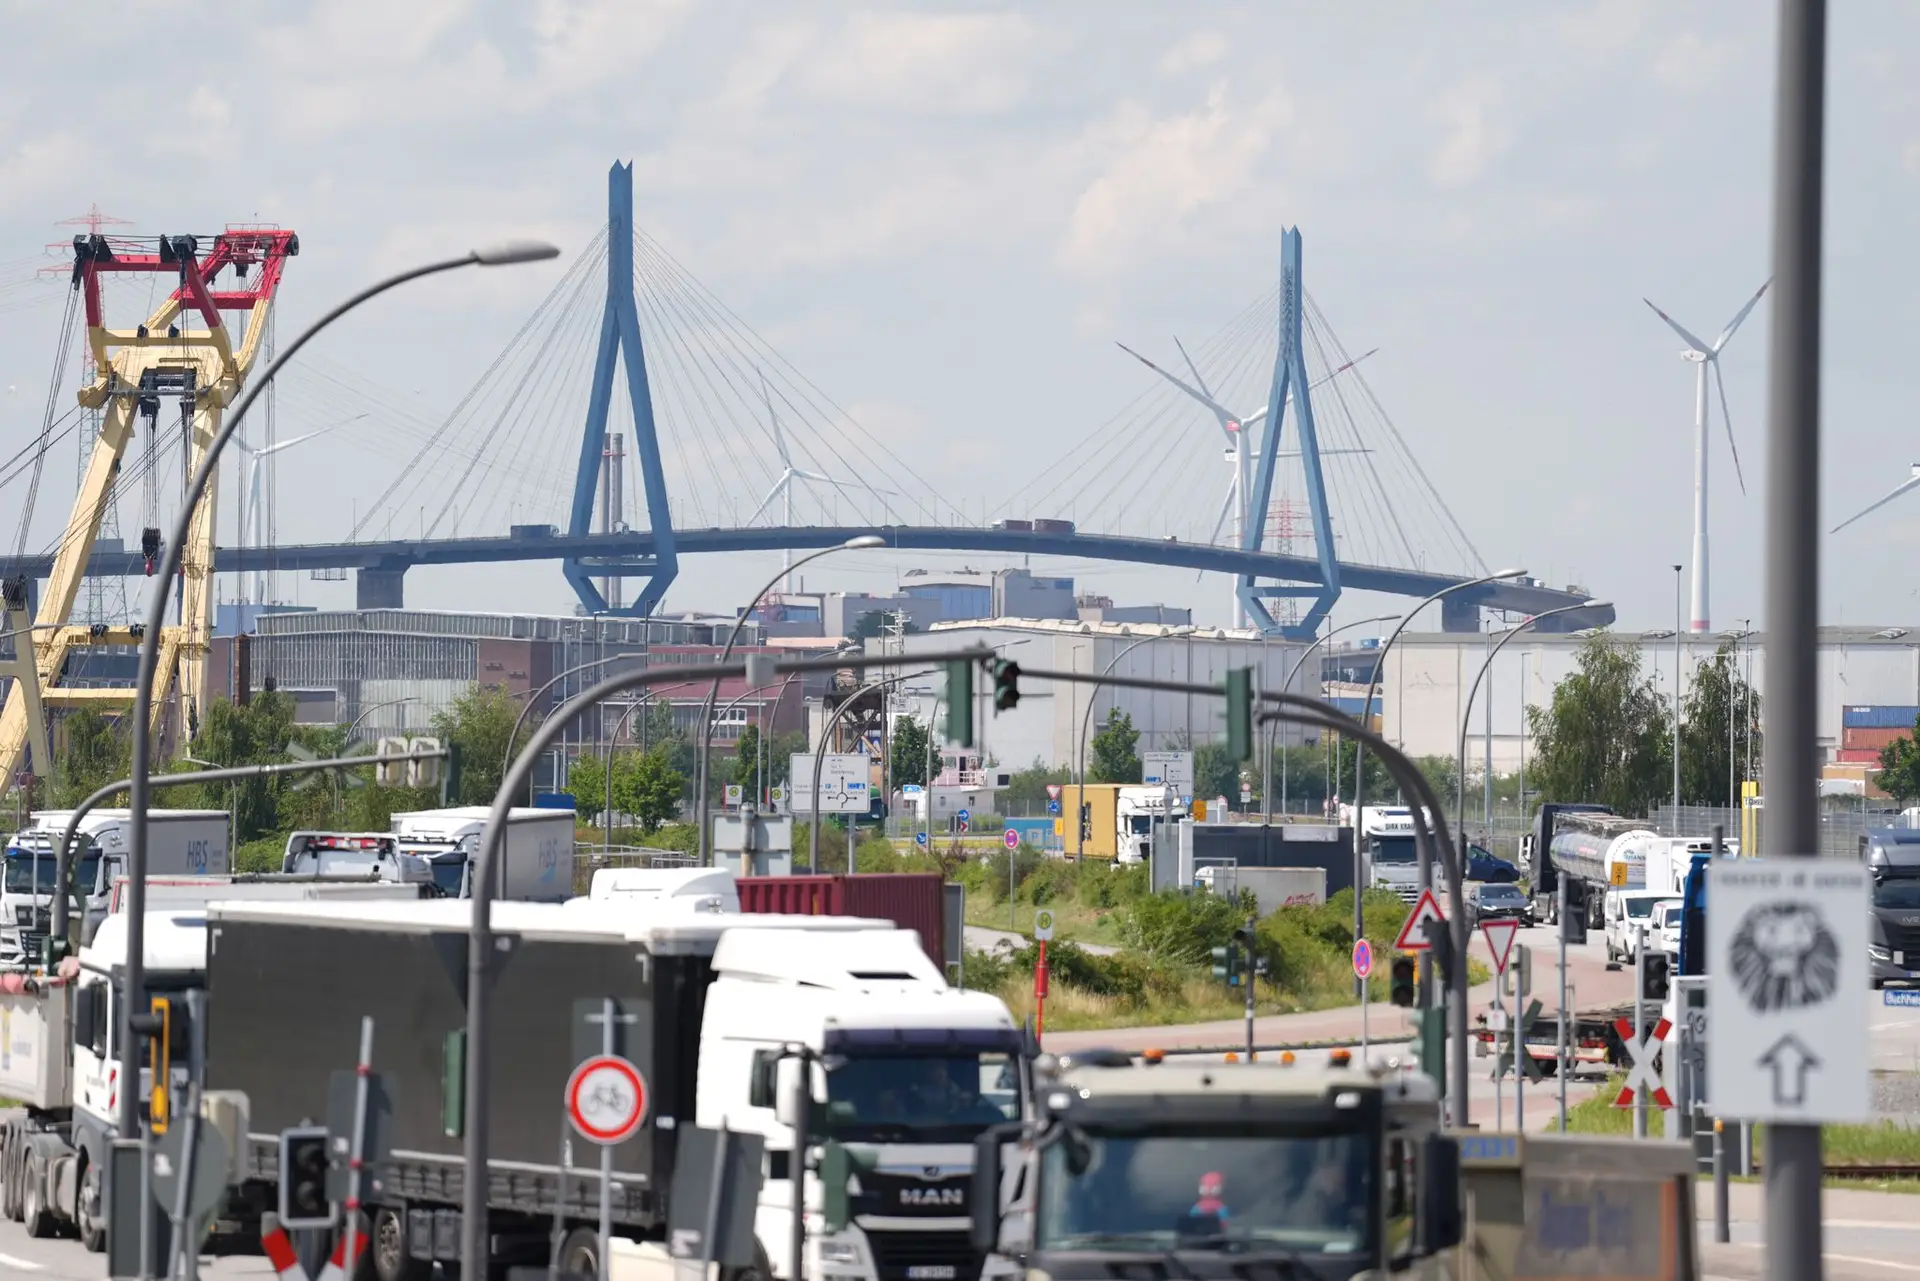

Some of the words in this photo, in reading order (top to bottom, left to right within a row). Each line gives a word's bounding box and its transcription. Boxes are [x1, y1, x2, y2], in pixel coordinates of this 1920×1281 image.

[187, 840, 208, 869] HBS
[539, 838, 557, 869] HBS
[899, 1188, 963, 1205] MAN
